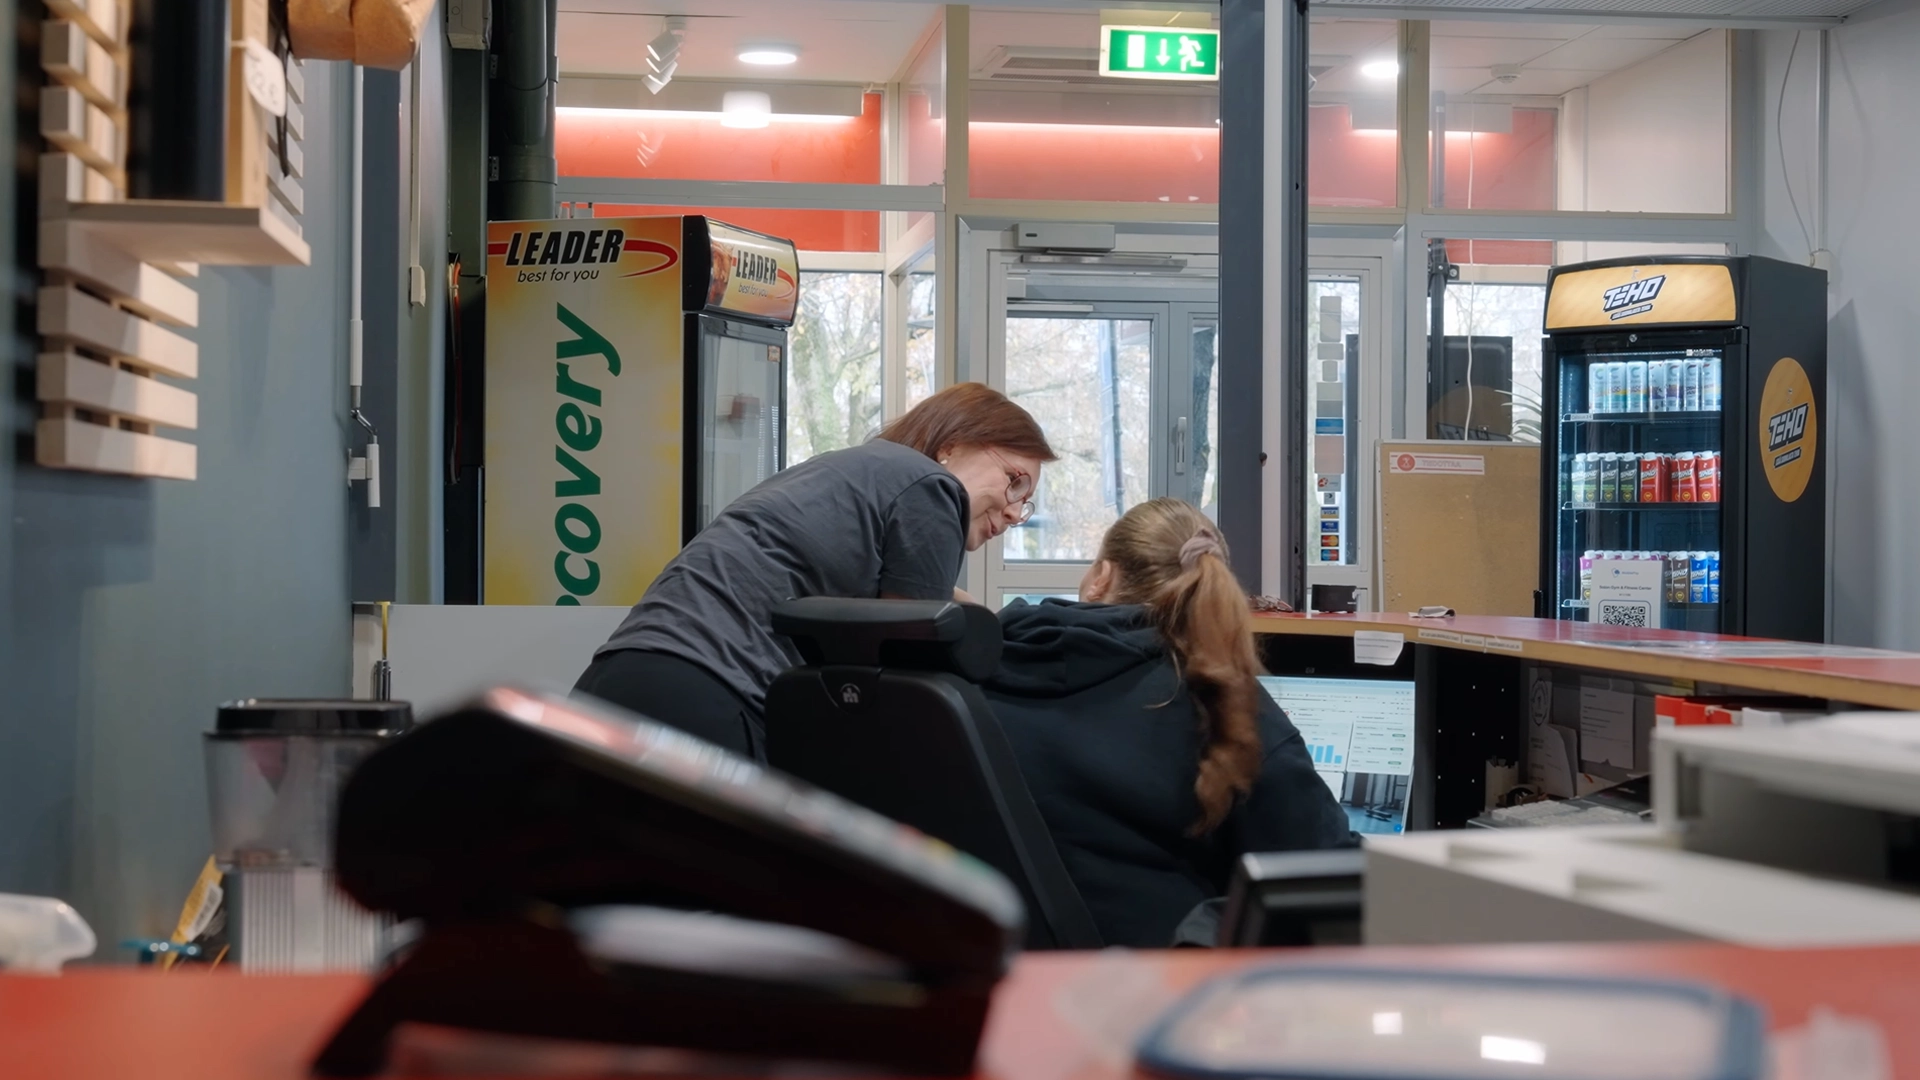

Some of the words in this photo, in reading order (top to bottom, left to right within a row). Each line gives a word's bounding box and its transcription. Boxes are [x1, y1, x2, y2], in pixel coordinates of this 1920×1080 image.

[506, 229, 624, 266] LEADER
[517, 269, 548, 283] best
[550, 267, 571, 281] for
[573, 268, 600, 284] you
[735, 250, 778, 286] LEADER
[1603, 275, 1665, 311] TEHO
[1769, 404, 1808, 450] TEHO
[554, 301, 622, 606] covery
